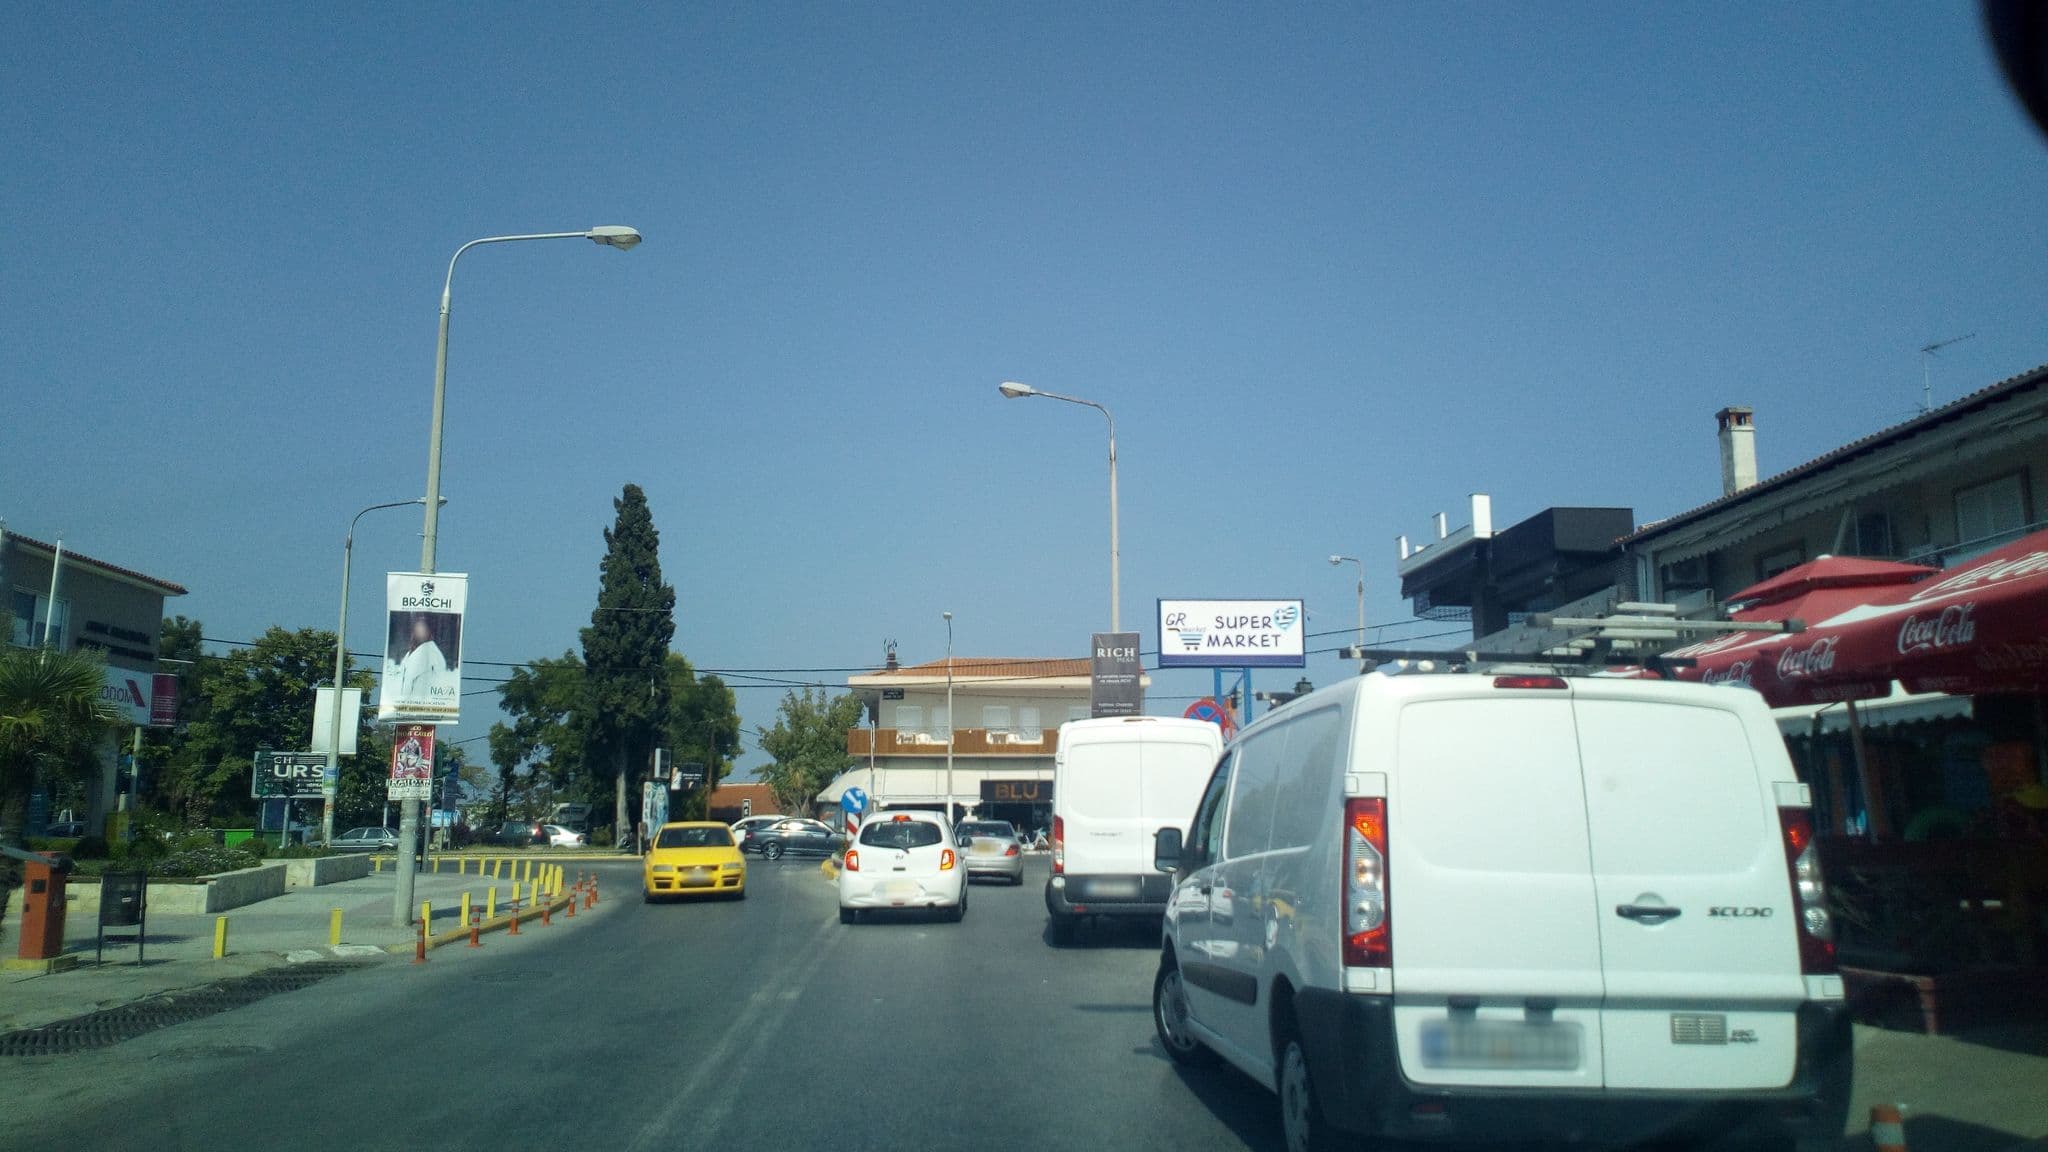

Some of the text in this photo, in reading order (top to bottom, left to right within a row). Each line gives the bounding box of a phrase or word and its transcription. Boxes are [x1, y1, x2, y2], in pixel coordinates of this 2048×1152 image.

[401, 597, 452, 609] BRASCHI
[1165, 612, 1187, 627] GR
[1215, 615, 1273, 630] SUPER
[1898, 602, 1976, 654] Coca-Cola
[1206, 634, 1282, 648] MARKET
[1096, 647, 1136, 658] RICH
[1776, 635, 1841, 681] Coca-Cola
[273, 756, 292, 764] CH
[270, 764, 323, 778] URS
[995, 783, 1039, 799] BLU
[1707, 906, 1774, 917] SCUDO
